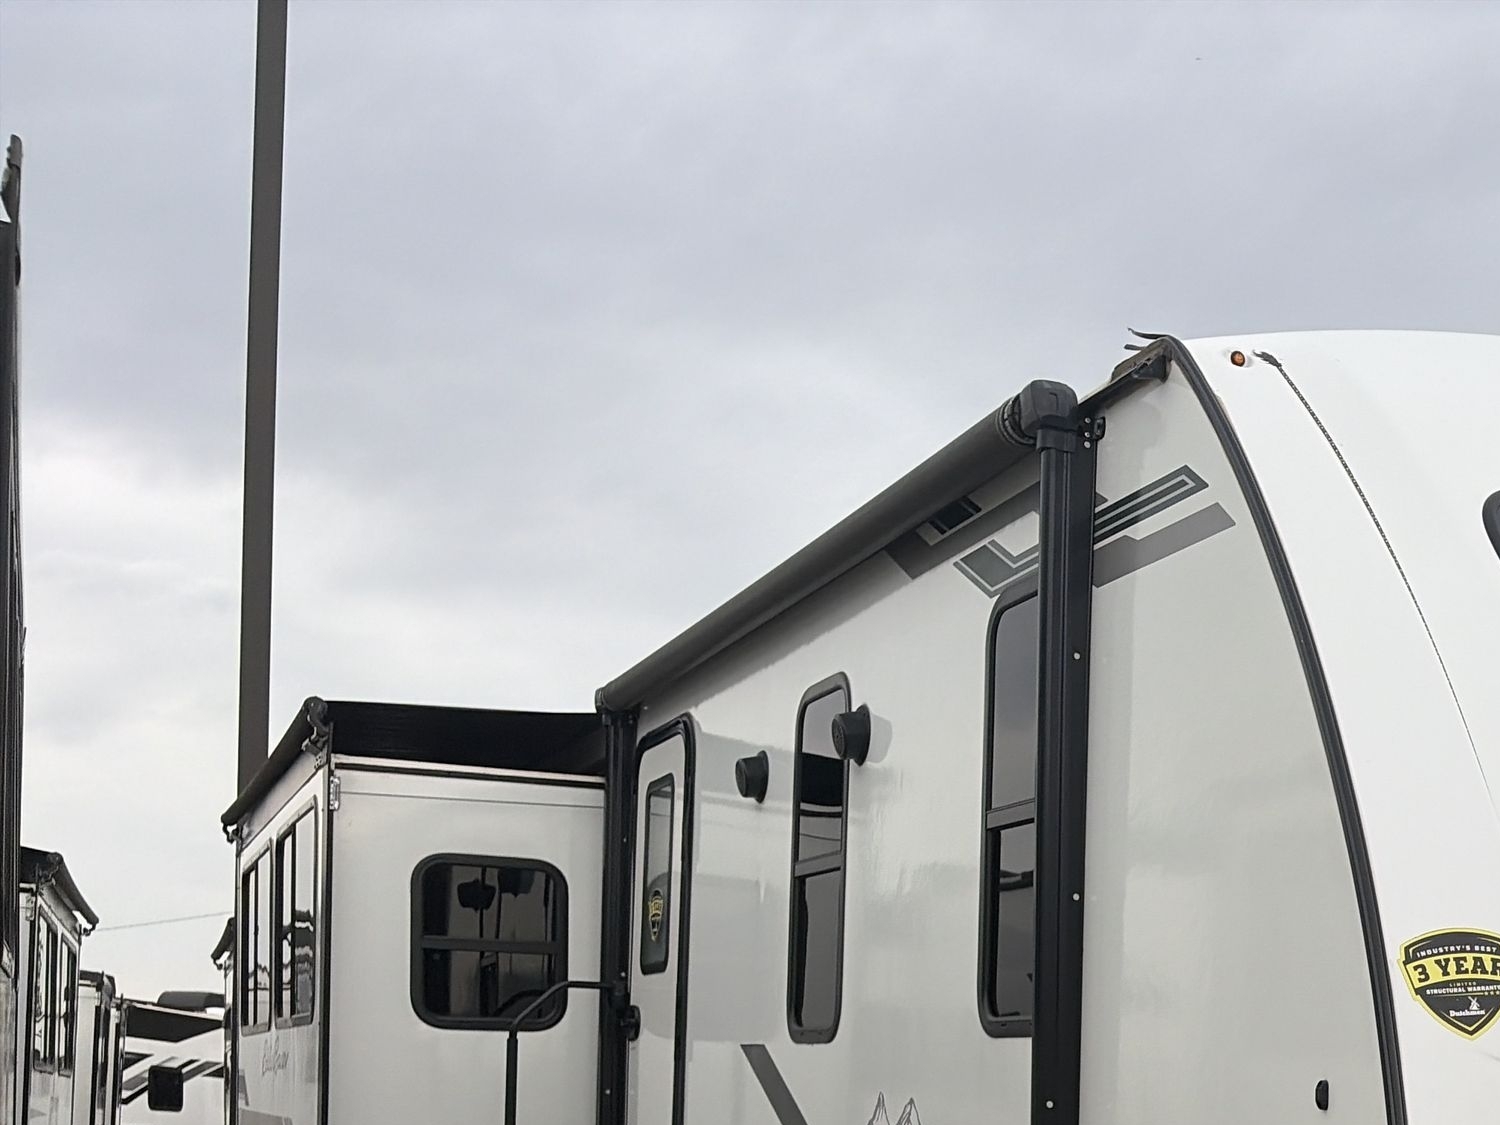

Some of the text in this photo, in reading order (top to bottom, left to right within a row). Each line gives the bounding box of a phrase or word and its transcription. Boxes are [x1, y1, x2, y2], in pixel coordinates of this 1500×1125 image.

[1416, 945, 1497, 958] INDUSTRY'S BEST
[1413, 963, 1431, 984] 3
[1426, 984, 1500, 995] STRUCTURAL WARRANTY
